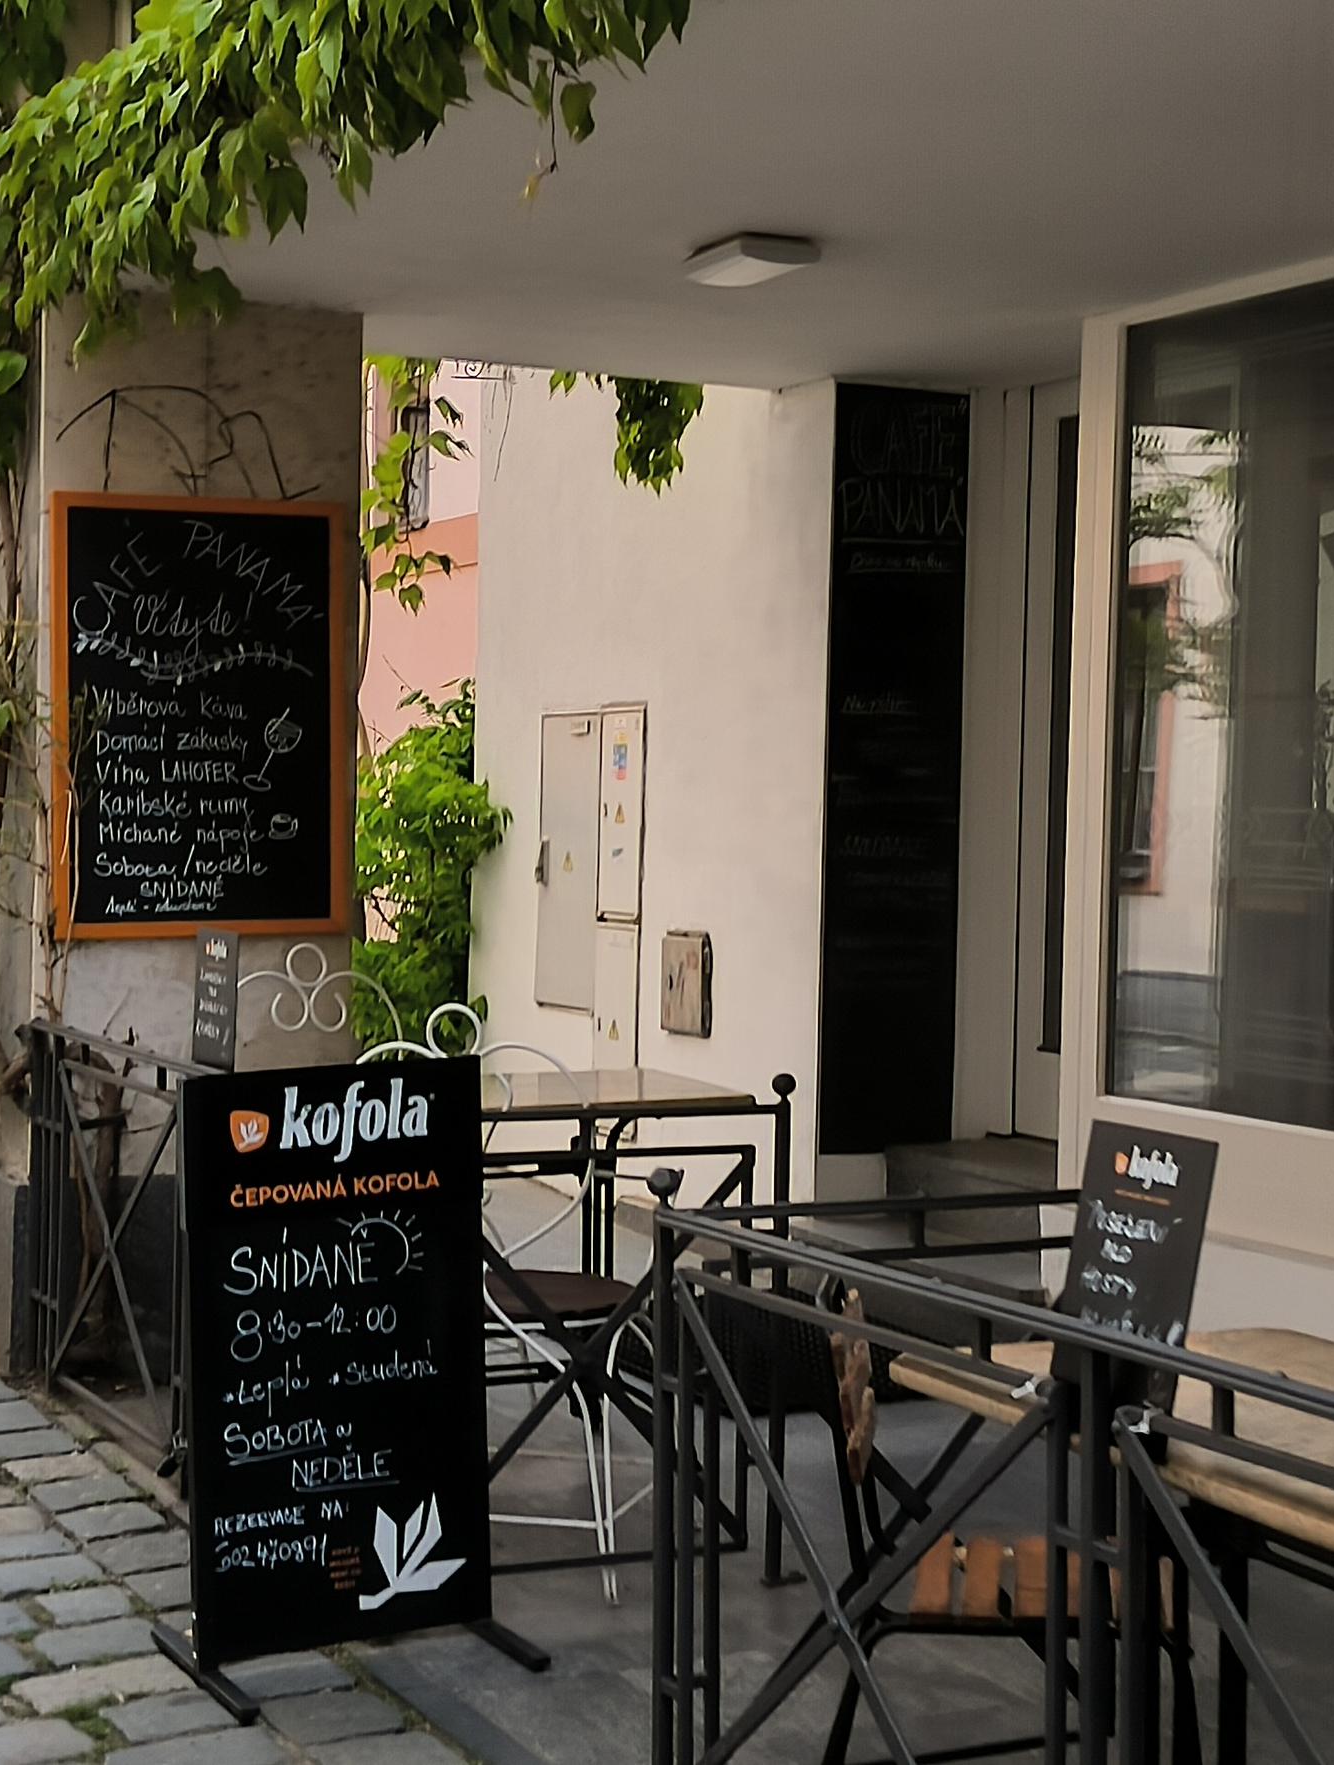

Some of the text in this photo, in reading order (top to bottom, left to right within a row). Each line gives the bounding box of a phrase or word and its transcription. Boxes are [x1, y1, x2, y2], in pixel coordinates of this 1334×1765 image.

[96, 755, 239, 786] Vína LAHOFER
[99, 788, 255, 823] Karibské rumy
[99, 820, 265, 854] Míchané nápoje
[280, 1077, 429, 1163] kofola
[230, 1170, 440, 1208] ČEPOVANÁ KOFOLA
[223, 1226, 378, 1295] SNÍDANĚ
